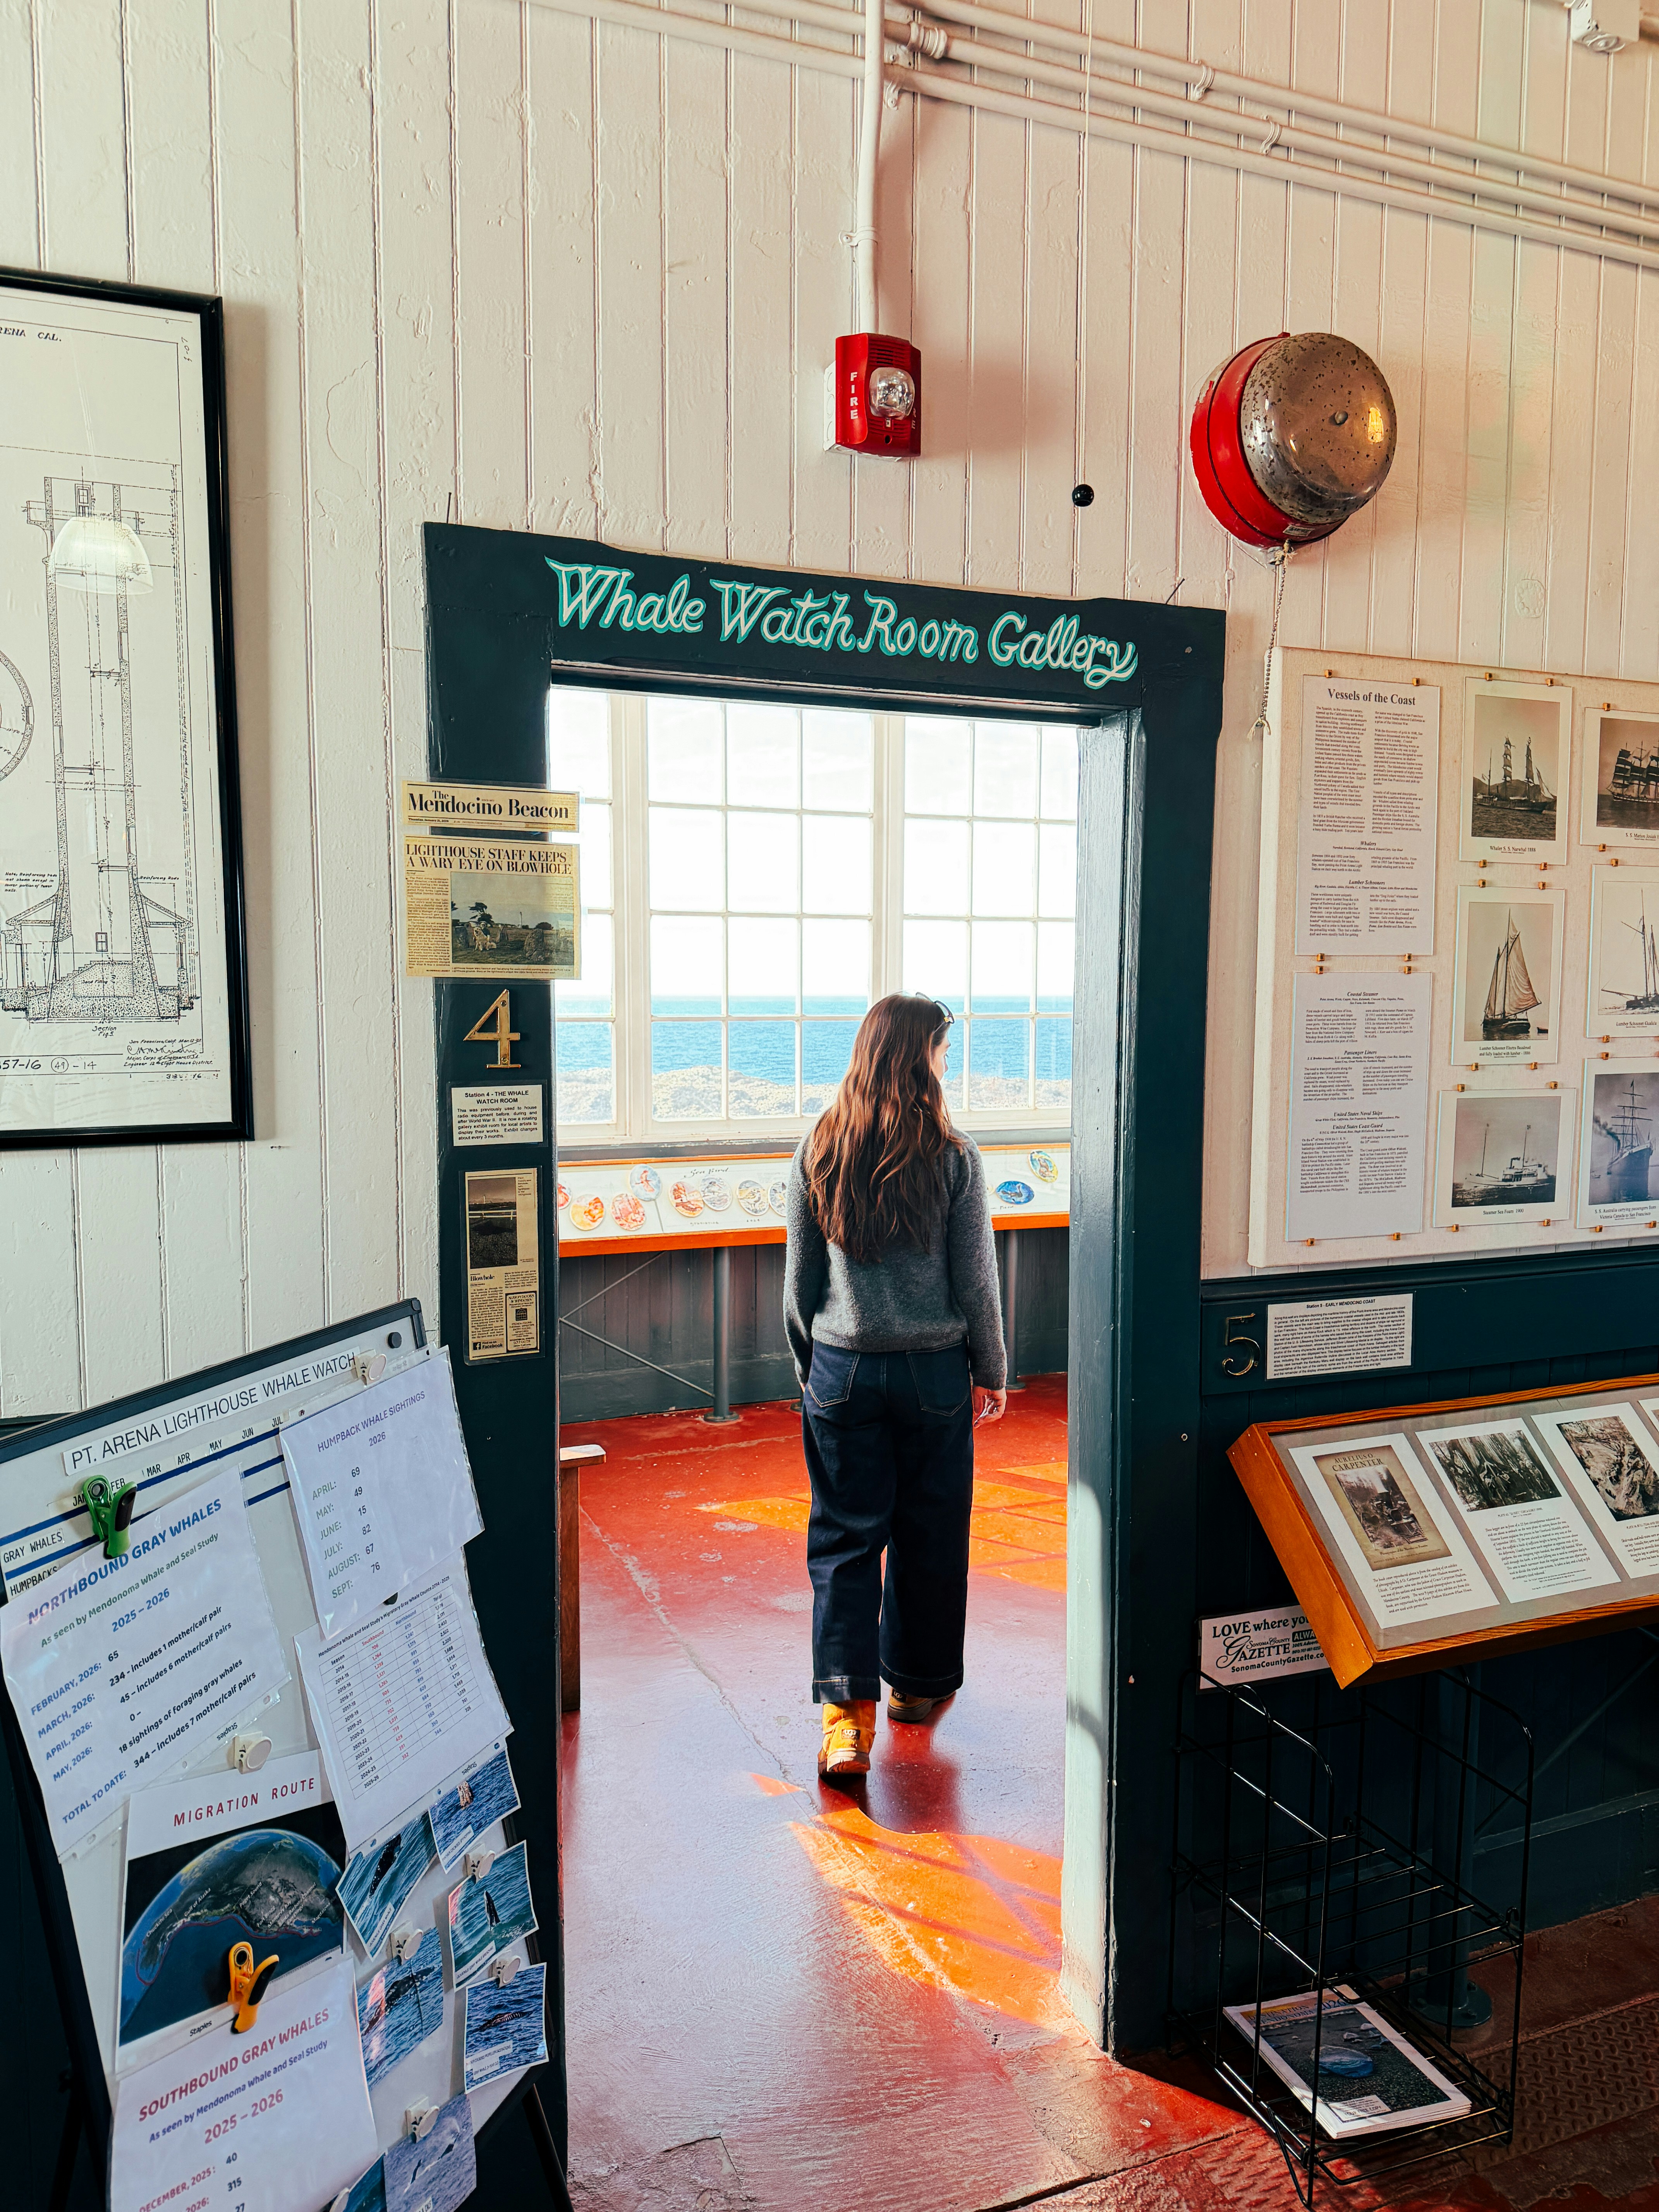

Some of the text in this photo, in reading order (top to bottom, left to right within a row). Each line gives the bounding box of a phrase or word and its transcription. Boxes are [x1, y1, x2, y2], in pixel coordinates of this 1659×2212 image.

[38, 332, 61, 341] CAL.
[850, 372, 858, 419] FIRE
[544, 555, 1139, 689] Whale Watch Room Gallery
[1328, 688, 1416, 706] Vessels of the Coast
[409, 793, 568, 818] Mendocino Beacon
[432, 790, 449, 800] The
[407, 844, 566, 863] LIGHTHOUSE STAFF KEEPS
[407, 857, 572, 874] A WARY EYE ON BLOWHOLE
[463, 989, 521, 1068] 4
[1222, 1313, 1261, 1376] 5
[72, 1352, 356, 1469] PT. ARENA LIGHTHOUSE WHALE WATCH
[272, 1417, 283, 1427] JUL
[318, 1391, 425, 1453] HUMPBACK WHALE SIGHTINGS
[210, 1440, 223, 1451] MAY
[242, 1428, 254, 1439] JUN
[369, 1431, 386, 1447] 2026
[147, 1464, 161, 1477] MAR
[178, 1453, 191, 1465] APR
[1332, 1458, 1384, 1471] CARPENTER
[1334, 1454, 1367, 1463] AURELIUS
[111, 1479, 125, 1490] FEB
[313, 1467, 360, 1501] APRIL: 69
[316, 1487, 362, 1520] MAY: 49
[321, 1506, 366, 1540] JUNE: 15
[4, 1532, 62, 1563] GRAY WHALES
[324, 1524, 371, 1560] JULY: 82
[29, 1498, 221, 1625] NORTHBOUND GRAY WHALES
[328, 1544, 374, 1580] AUGUST: 67
[10, 1566, 58, 1596] HUMPBACKS
[41, 1533, 218, 1648] As seen by Mendonoma Whale and Seal Study
[332, 1562, 380, 1599] SEPT: 76
[112, 1589, 170, 1632] 2025 2026
[1213, 1621, 1251, 1638] LOVE
[1253, 1616, 1289, 1632] where
[1216, 1635, 1290, 1668] GAZETTE
[1246, 1640, 1269, 1649] SONOMA
[31, 1651, 119, 1716] FEBRUARY, 2026: 65
[38, 1711, 71, 1738] MARCH,
[72, 1693, 95, 1714] 2026:
[110, 1671, 125, 1687] 234
[131, 1648, 162, 1673] includes
[168, 1614, 207, 1648] mother/calf
[209, 1606, 222, 1621] pair
[46, 1740, 71, 1760] APRIL,
[70, 1721, 93, 1741] 2026:
[120, 1693, 130, 1704] 45
[136, 1668, 168, 1693] includes
[174, 1633, 213, 1666] mother/calf
[215, 1623, 232, 1639] pairs
[119, 1659, 242, 1754] 18 sightings of foraging gray whales
[53, 1764, 72, 1782] MAY,
[72, 1747, 93, 1766] 2026:
[62, 1800, 91, 1824] TOTAL
[91, 1789, 103, 1802] TO
[104, 1770, 127, 1793] DATE:
[134, 1752, 150, 1768] 344
[156, 1723, 189, 1751] includes
[196, 1686, 234, 1721] mother/calf
[238, 1672, 256, 1691] pairs
[174, 1778, 314, 1827] MIGRATION ROUTE
[190, 2020, 212, 2037] Staples
[139, 2008, 329, 2122] SOUTHBOUND GRAY WHALES
[149, 2040, 327, 2143] As seen by Mendonoma Whale and Seal Study
[205, 2089, 283, 2144] 2025 2026
[139, 2181, 190, 2212] DECEMBER,
[226, 2152, 237, 2164] 40
[227, 2178, 242, 2191] 315
